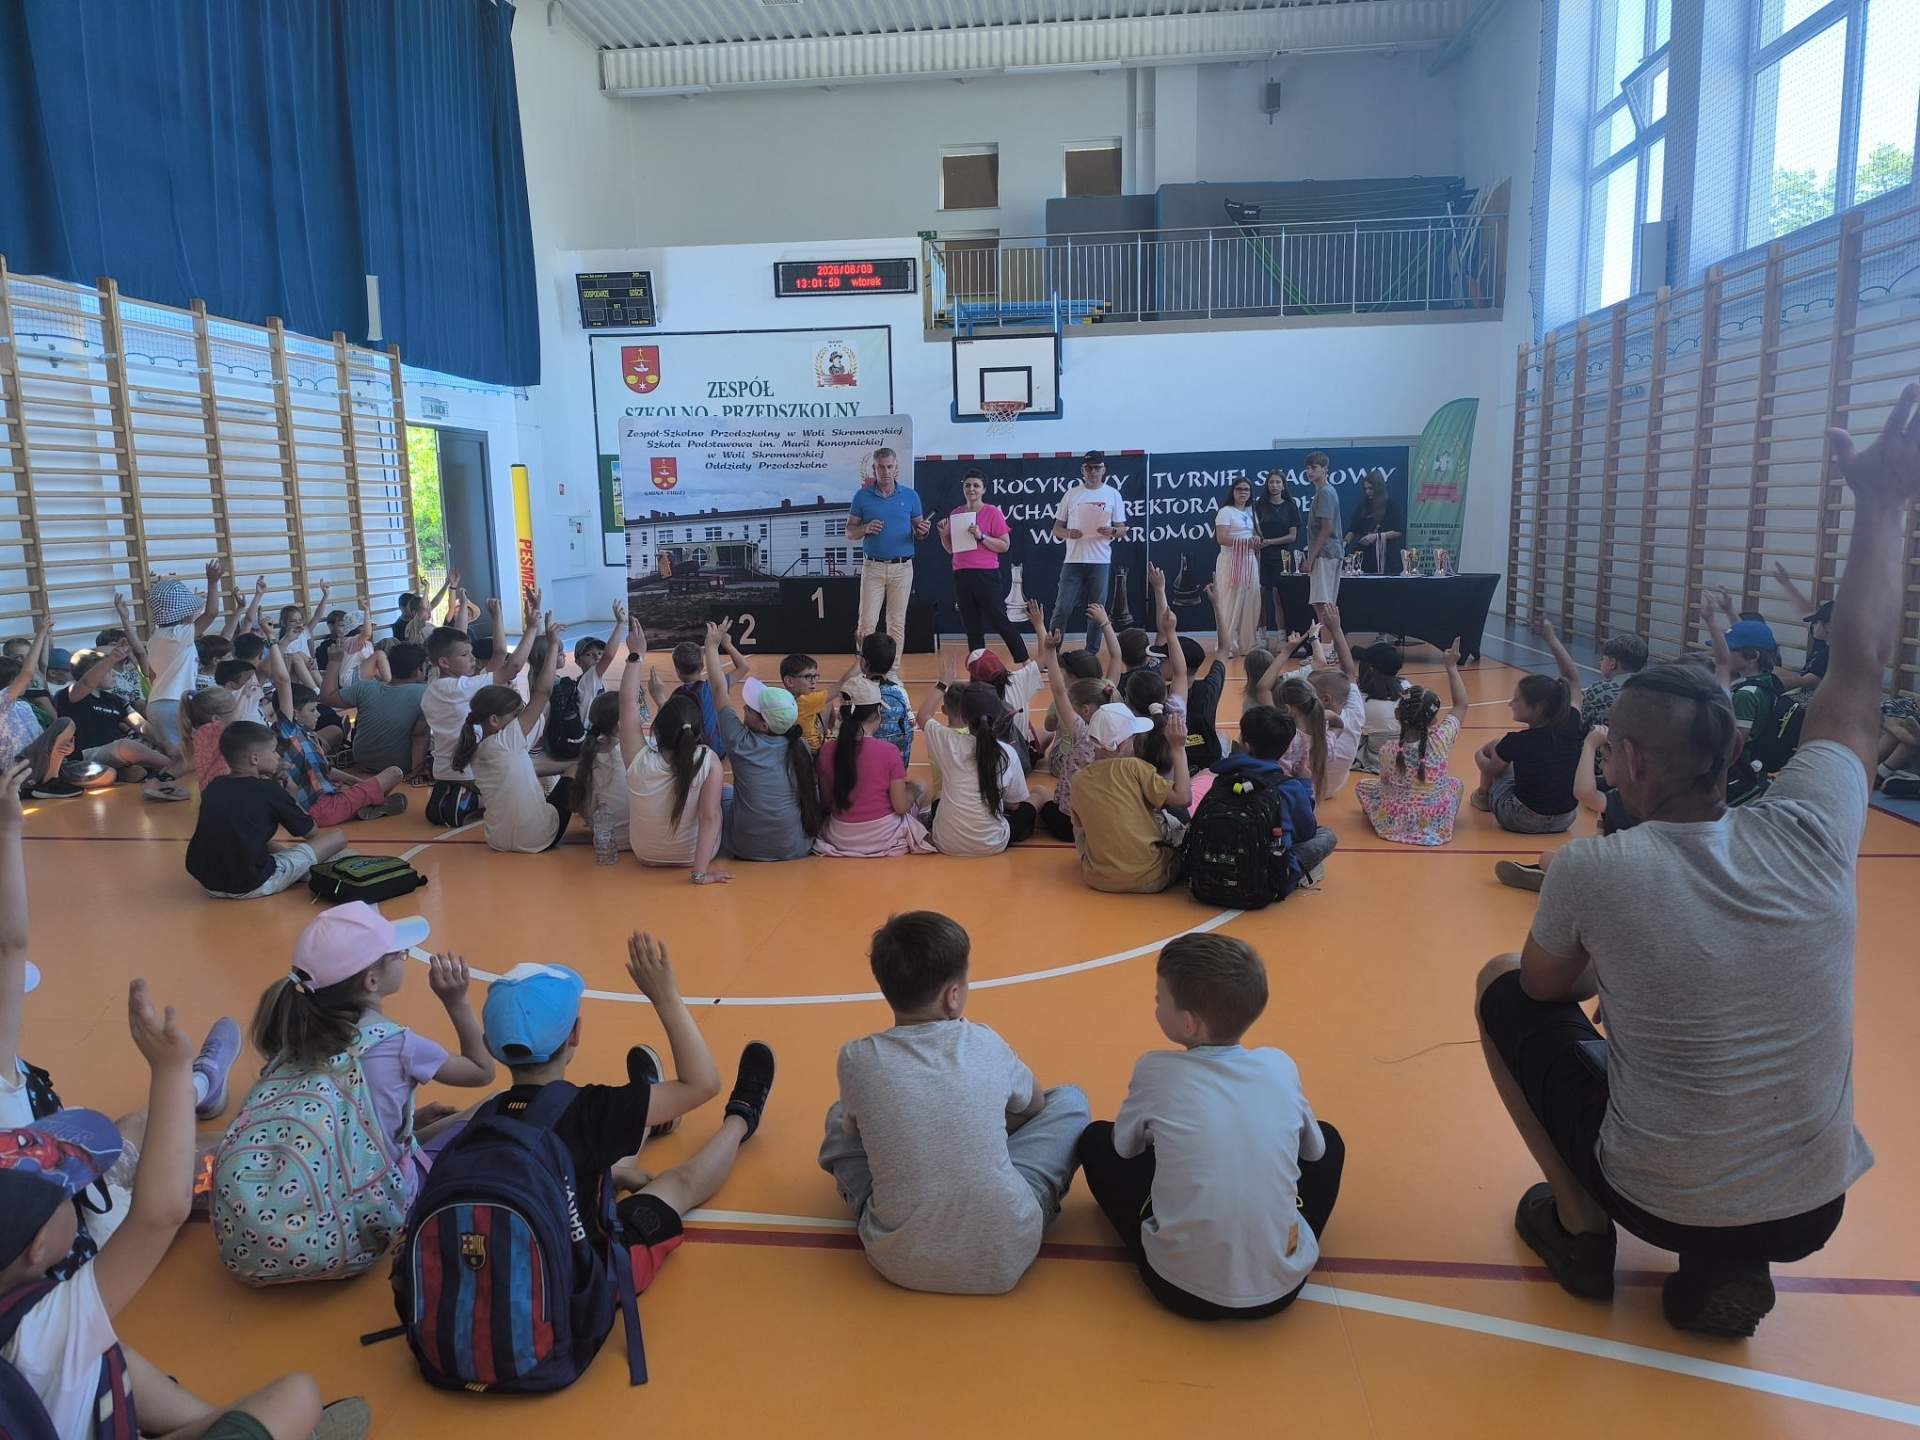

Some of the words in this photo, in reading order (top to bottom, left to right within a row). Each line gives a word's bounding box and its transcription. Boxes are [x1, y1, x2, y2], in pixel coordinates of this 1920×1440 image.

[850, 277, 881, 288] wtorek
[707, 376, 775, 399] ZESPÓŁ
[803, 429, 825, 438] Woli
[832, 426, 903, 437] Skromowskiej
[687, 439, 753, 449] Podstawowa
[760, 439, 776, 448] im.
[782, 438, 810, 448] Marii
[817, 437, 884, 448] Konopnickiej
[723, 450, 745, 459] Woli
[752, 450, 824, 459] Skromowskiej
[705, 461, 752, 471] Oddziały
[758, 461, 828, 471] Przedszkolne
[811, 586, 824, 619] 1
[739, 613, 757, 645] 2
